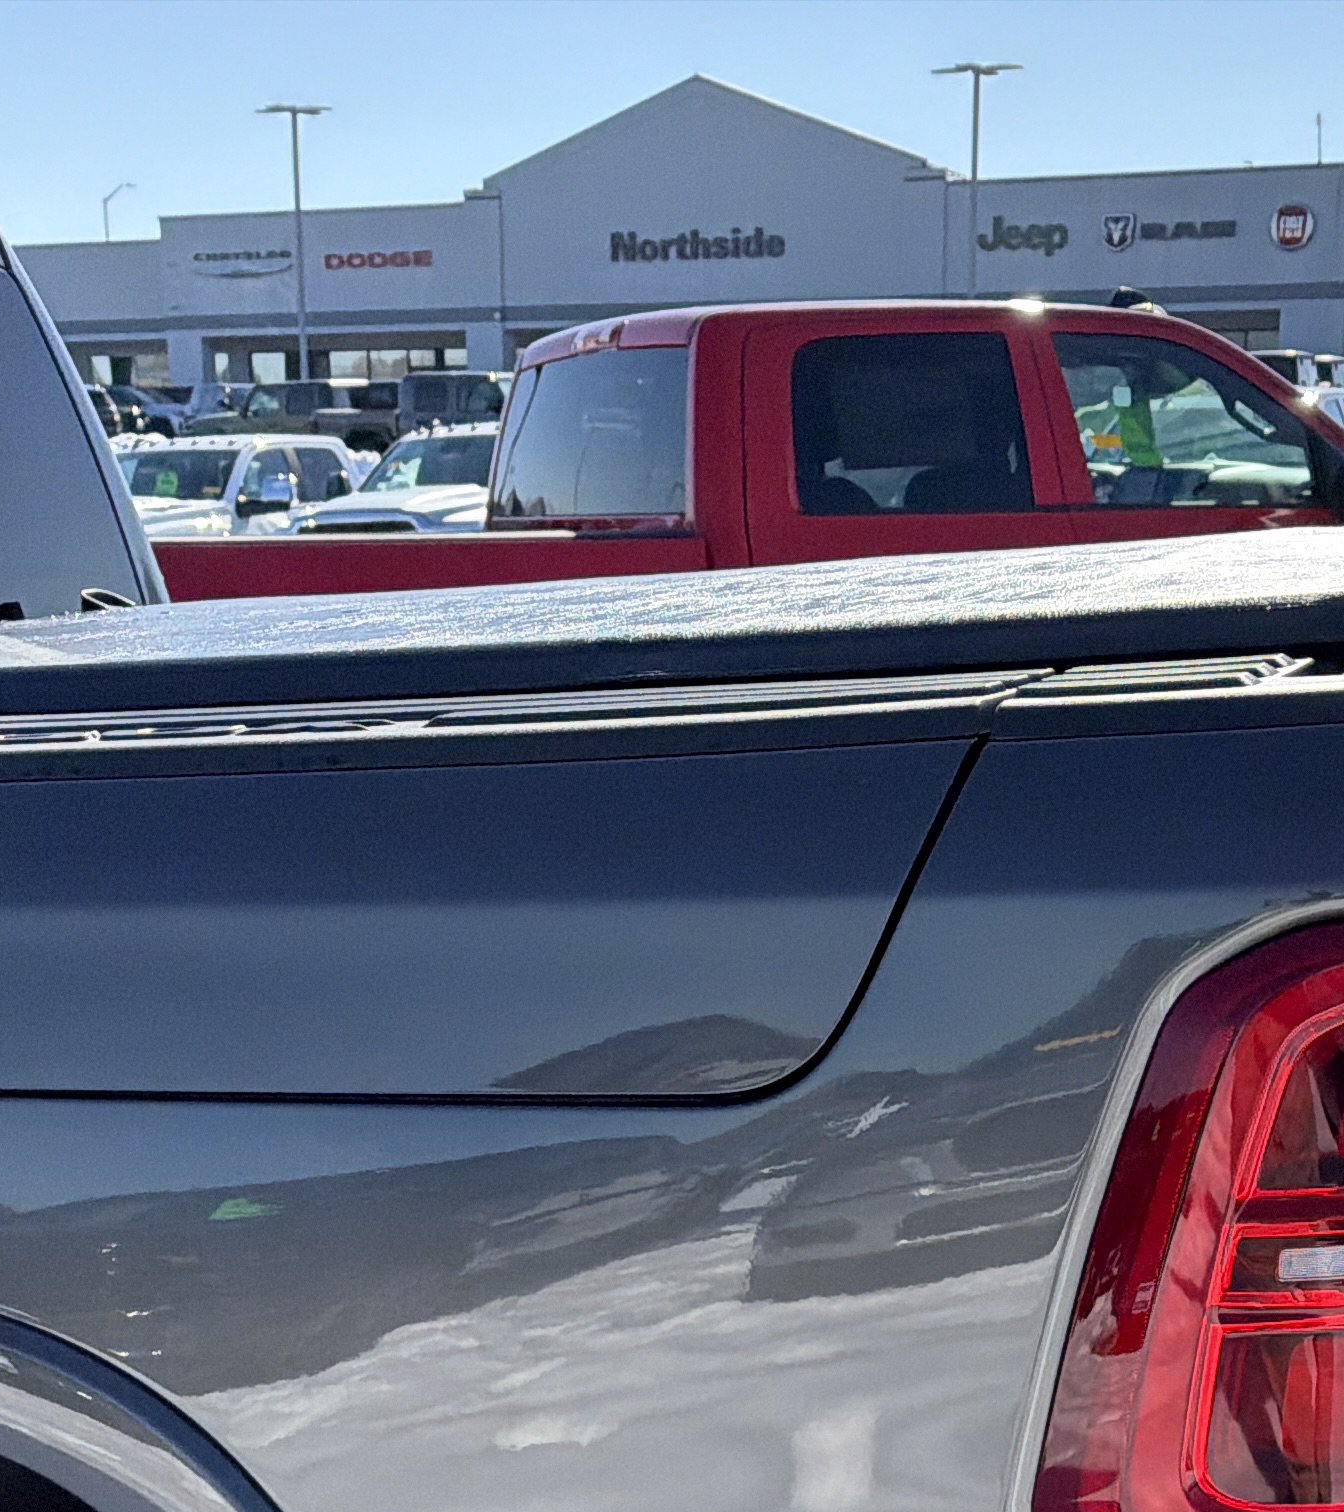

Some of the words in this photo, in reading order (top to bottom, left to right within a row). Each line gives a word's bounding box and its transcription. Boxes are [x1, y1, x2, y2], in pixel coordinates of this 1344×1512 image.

[610, 226, 786, 262] Northside
[977, 215, 1068, 256] Jeep
[323, 250, 433, 270] DODGE
